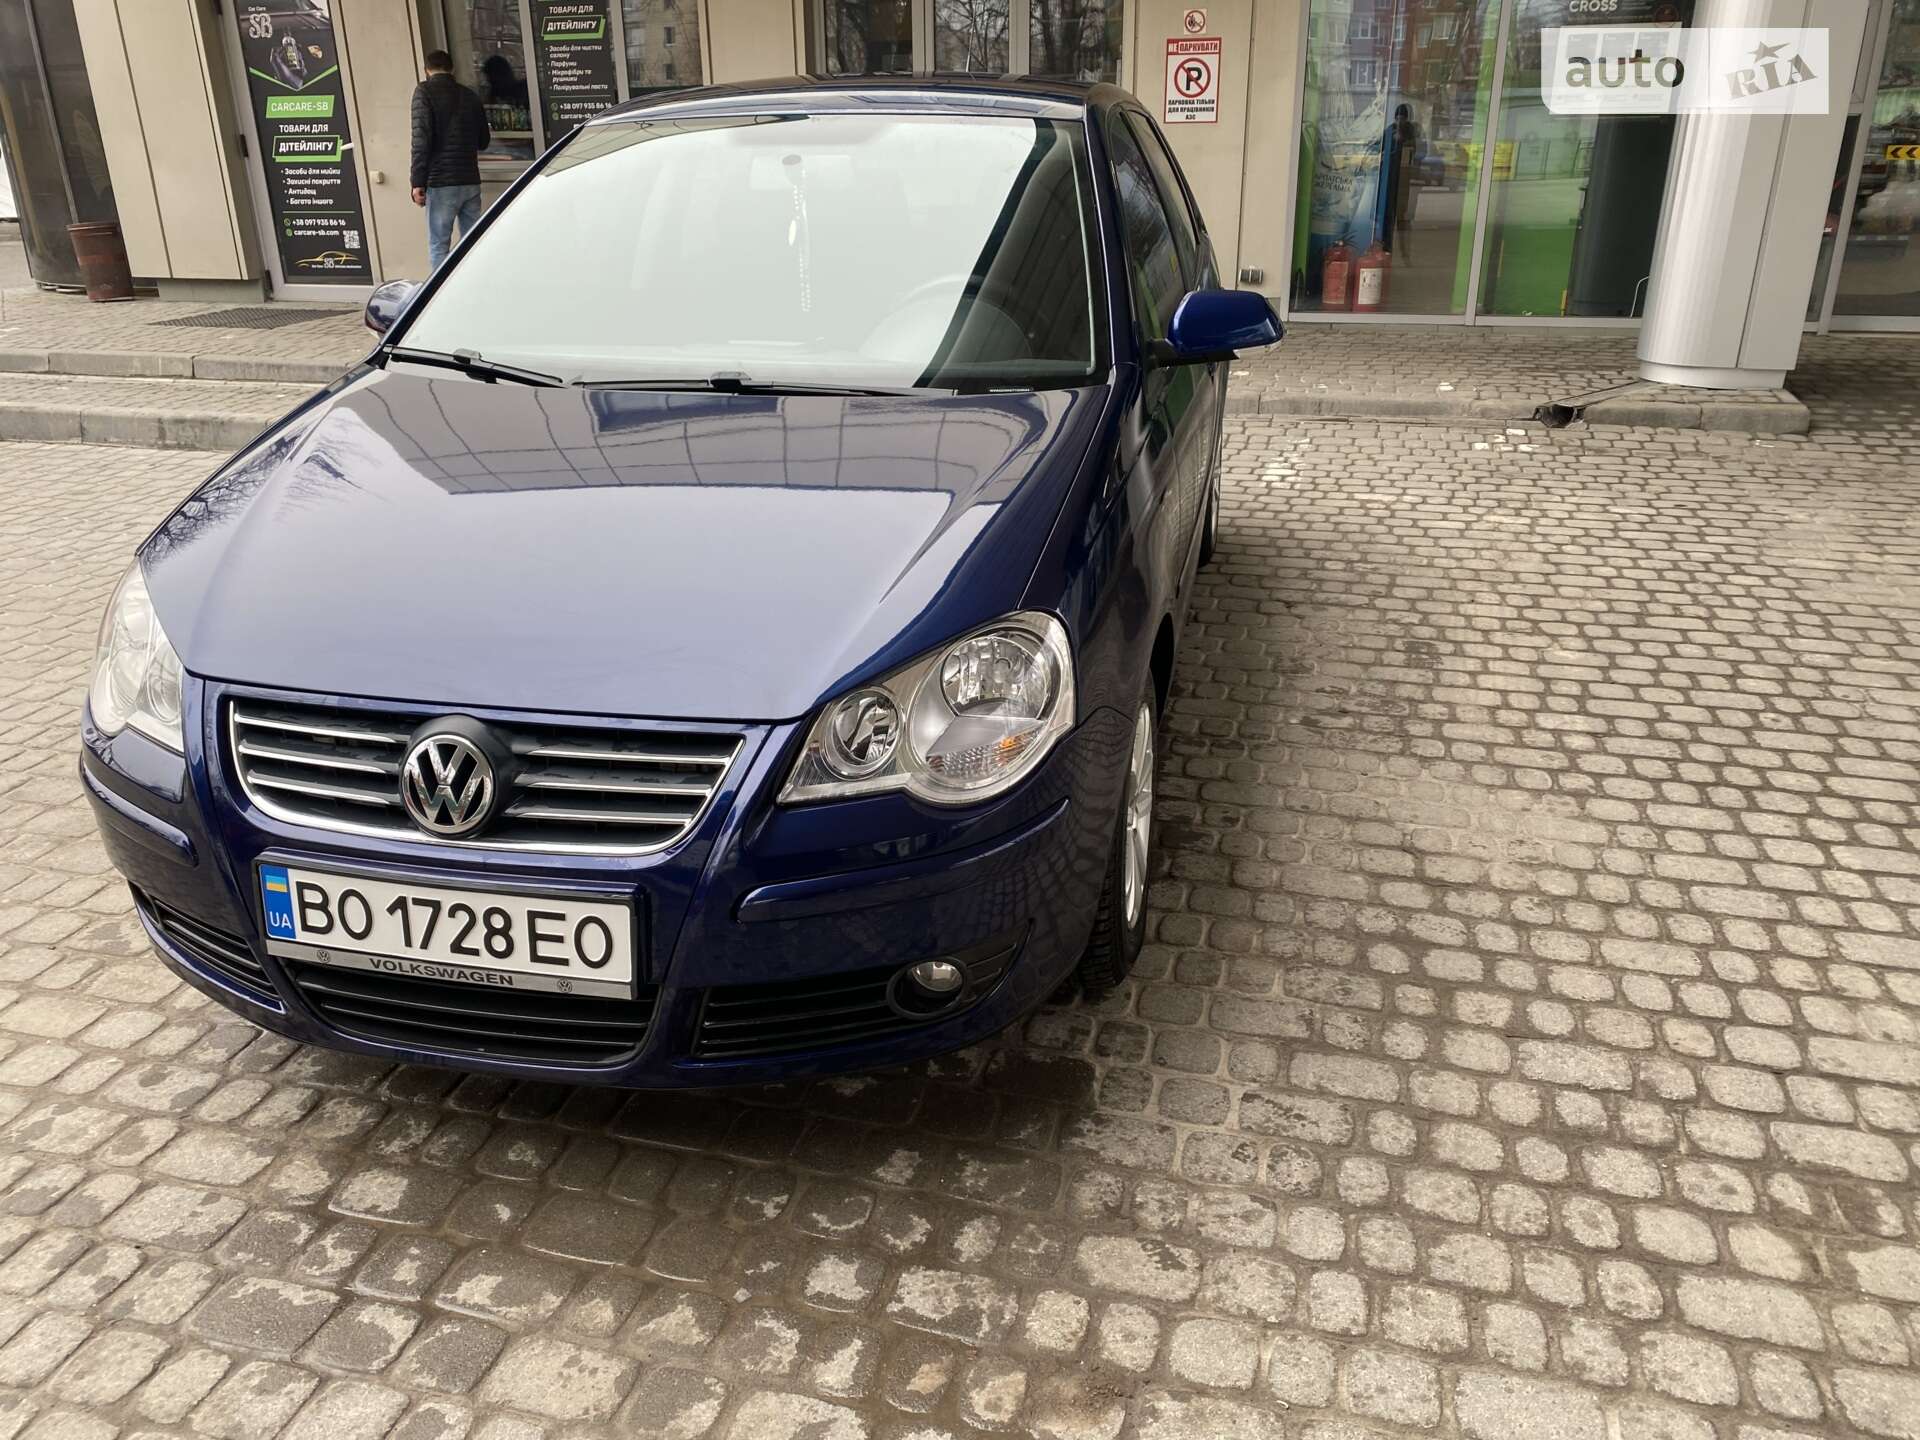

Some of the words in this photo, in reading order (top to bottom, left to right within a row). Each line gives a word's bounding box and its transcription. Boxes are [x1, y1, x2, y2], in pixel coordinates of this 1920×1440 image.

[549, 6, 577, 14] ТОВАРИ
[578, 5, 594, 14] ДЛЯ
[1569, 0, 1618, 12] CROSS
[249, 13, 273, 38] SB
[547, 20, 597, 31] ДІТЕЙЛІНГУ
[271, 102, 328, 112] CARCARE-SB
[279, 125, 311, 133] ТОВАРИ
[312, 124, 328, 133] ДЛЯ
[279, 141, 334, 152] ДІТЕЙЛІНГУ
[402, 734, 495, 834] VW
[269, 911, 293, 930] UA
[295, 880, 374, 940] BO
[385, 895, 514, 960] 1728
[526, 909, 614, 969] EO
[369, 957, 514, 987] VOLKSWAGEN
